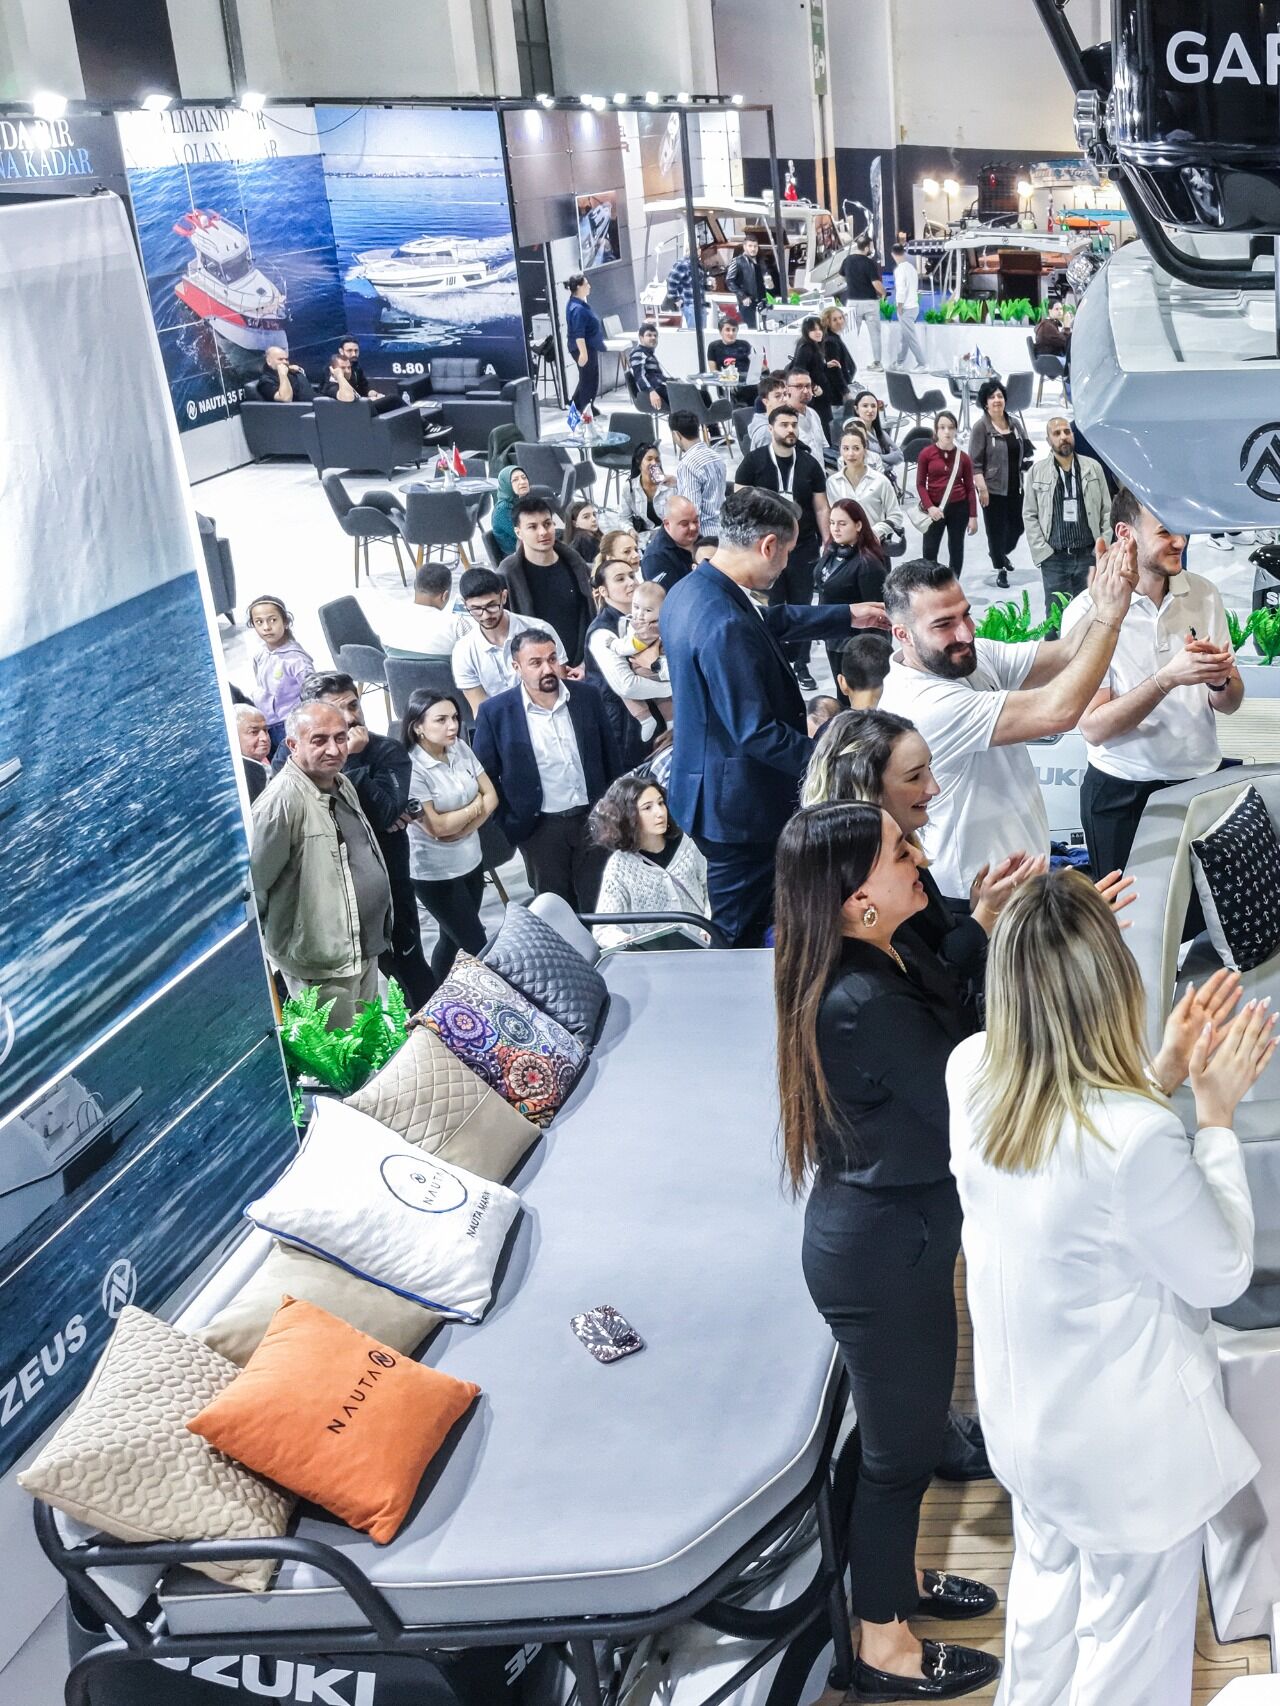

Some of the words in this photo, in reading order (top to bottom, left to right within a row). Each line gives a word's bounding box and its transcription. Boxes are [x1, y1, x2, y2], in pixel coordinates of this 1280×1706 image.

[21, 148, 93, 177] KADAR
[392, 362, 425, 375] 8.80
[198, 394, 227, 414] NAUTA
[227, 390, 238, 404] 35
[466, 1209, 485, 1239] NAUTA
[0, 1314, 87, 1428] ZEUS
[326, 1369, 383, 1434] NAUTA
